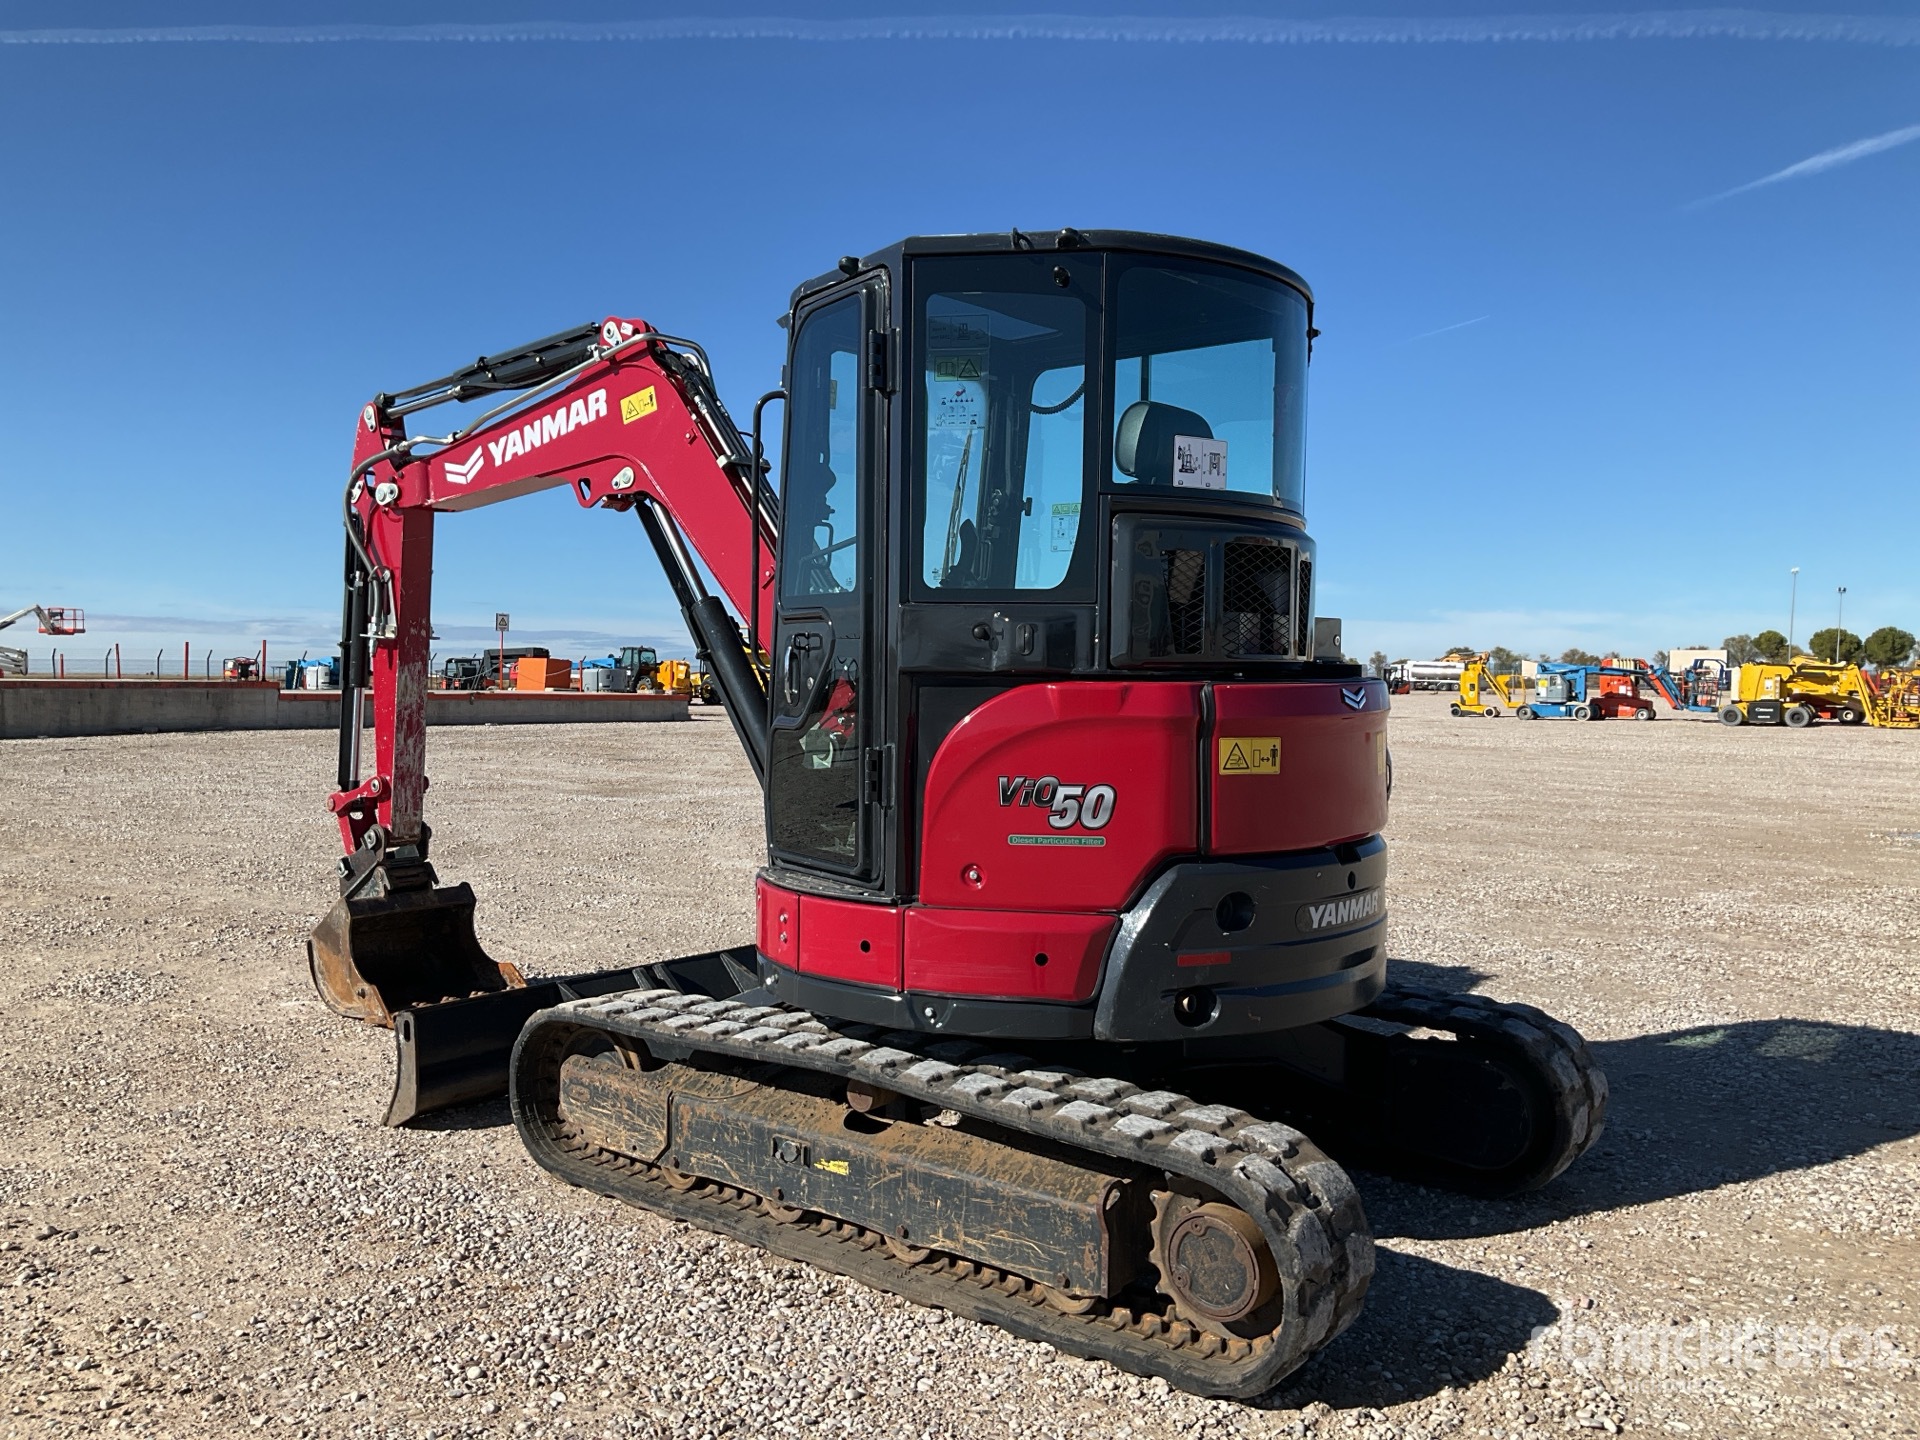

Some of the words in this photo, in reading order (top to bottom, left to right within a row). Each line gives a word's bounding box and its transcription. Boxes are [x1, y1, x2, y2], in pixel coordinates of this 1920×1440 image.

[488, 388, 608, 467] YANMAR
[1037, 837, 1079, 845] Particulate
[1308, 891, 1379, 929] YANMAR
